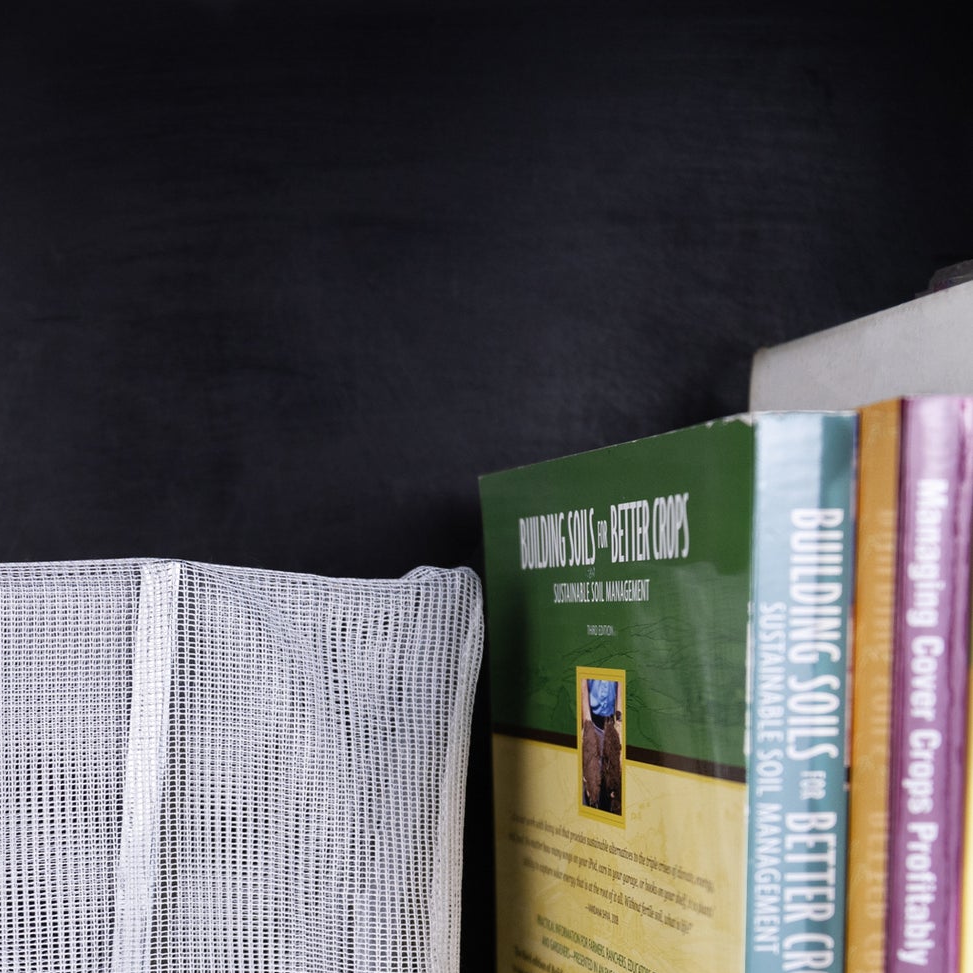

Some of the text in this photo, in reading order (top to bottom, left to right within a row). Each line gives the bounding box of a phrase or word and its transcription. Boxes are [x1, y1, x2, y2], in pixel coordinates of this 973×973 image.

[519, 492, 690, 570] BUILDING SOILS FOR BETTER CROPS
[906, 478, 949, 628] Managing
[553, 579, 650, 603] SUSTAINABLE SOIL MANAGEMENT
[787, 508, 844, 664] BUILDING
[786, 674, 841, 762] SOILS
[909, 635, 945, 721] Cover
[754, 601, 787, 955] SUSTAINABLE SOIL MANAGEMENT
[799, 770, 827, 800] FOR
[902, 728, 942, 815] Crops
[782, 811, 838, 924] BETTER
[897, 821, 939, 966] Profitably
